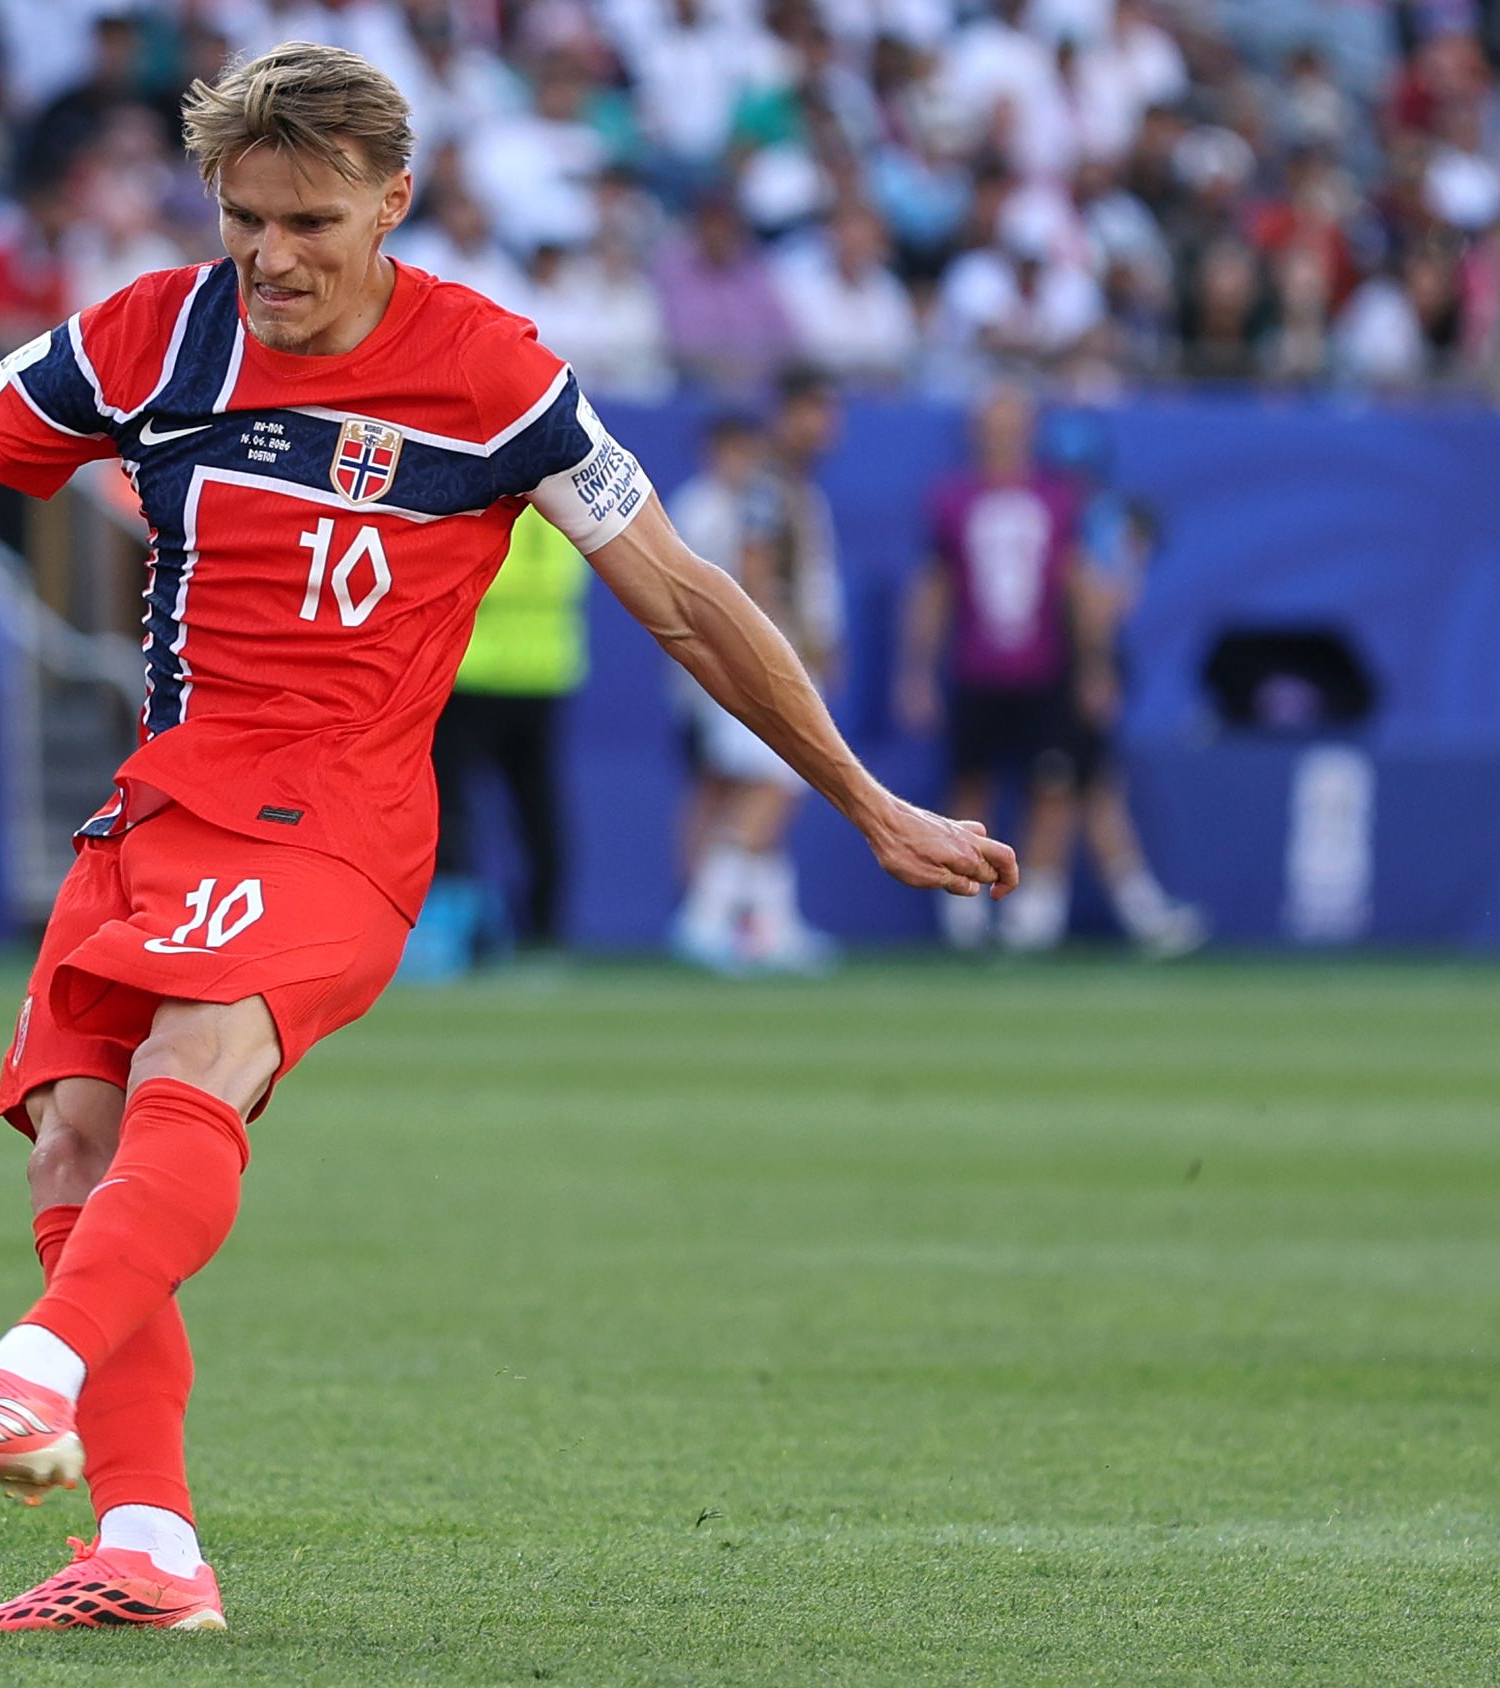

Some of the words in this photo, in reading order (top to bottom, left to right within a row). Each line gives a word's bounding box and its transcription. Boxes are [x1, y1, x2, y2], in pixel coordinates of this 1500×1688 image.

[248, 448, 277, 463] BOSTON
[571, 435, 611, 488] FOOTBALL
[578, 446, 624, 504] UNITES
[588, 498, 614, 522] the
[608, 455, 639, 500] World
[619, 490, 639, 516] FIFA
[299, 517, 392, 627] 10
[171, 878, 264, 947] 10
